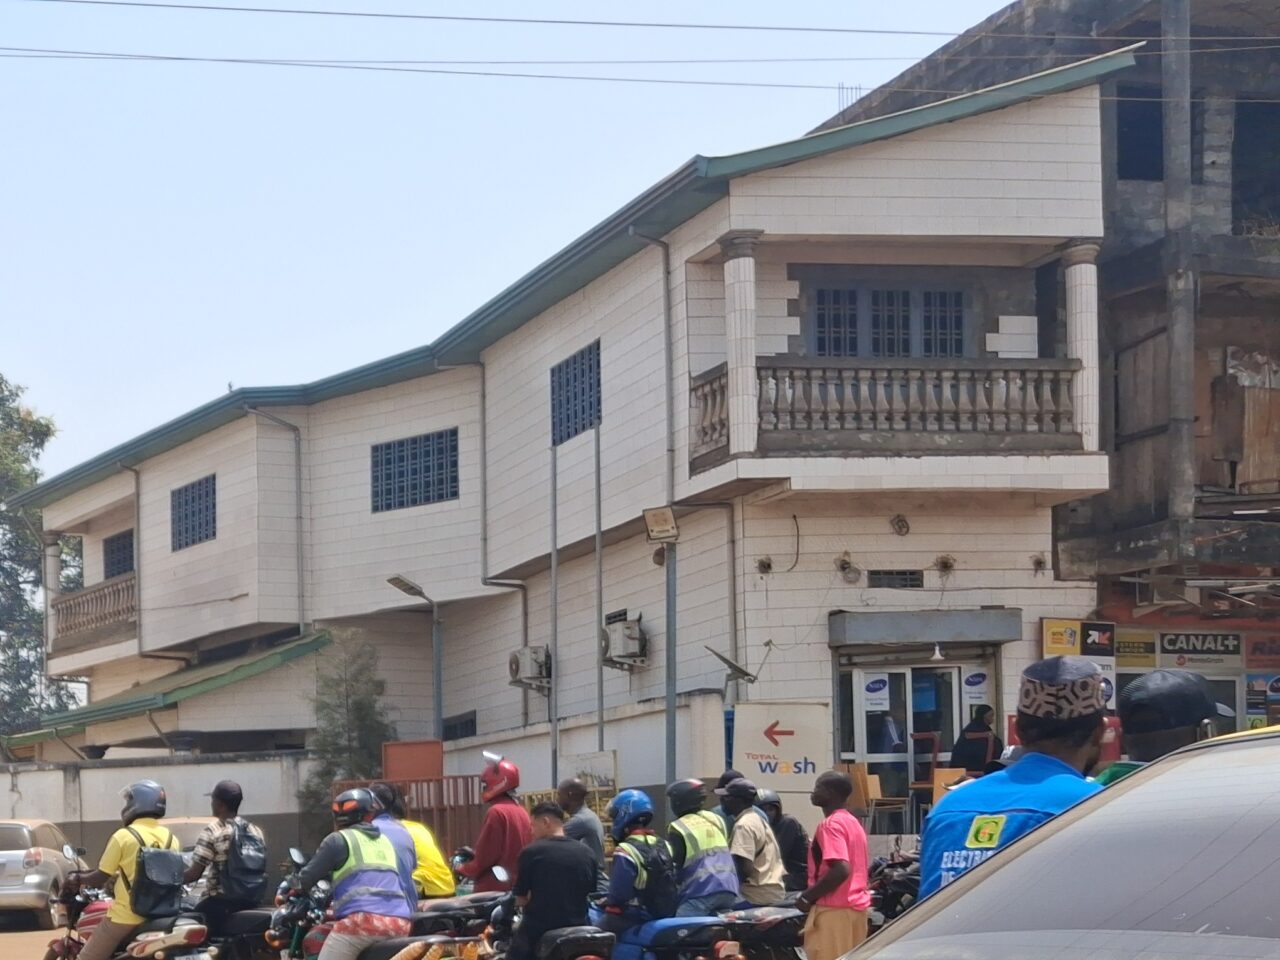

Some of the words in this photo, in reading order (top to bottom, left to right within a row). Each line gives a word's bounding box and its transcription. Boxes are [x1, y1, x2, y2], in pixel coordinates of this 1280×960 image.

[1163, 634, 1238, 651] CANAL+
[744, 752, 779, 761] TOTAL
[758, 756, 816, 774] wash
[973, 820, 999, 843] G
